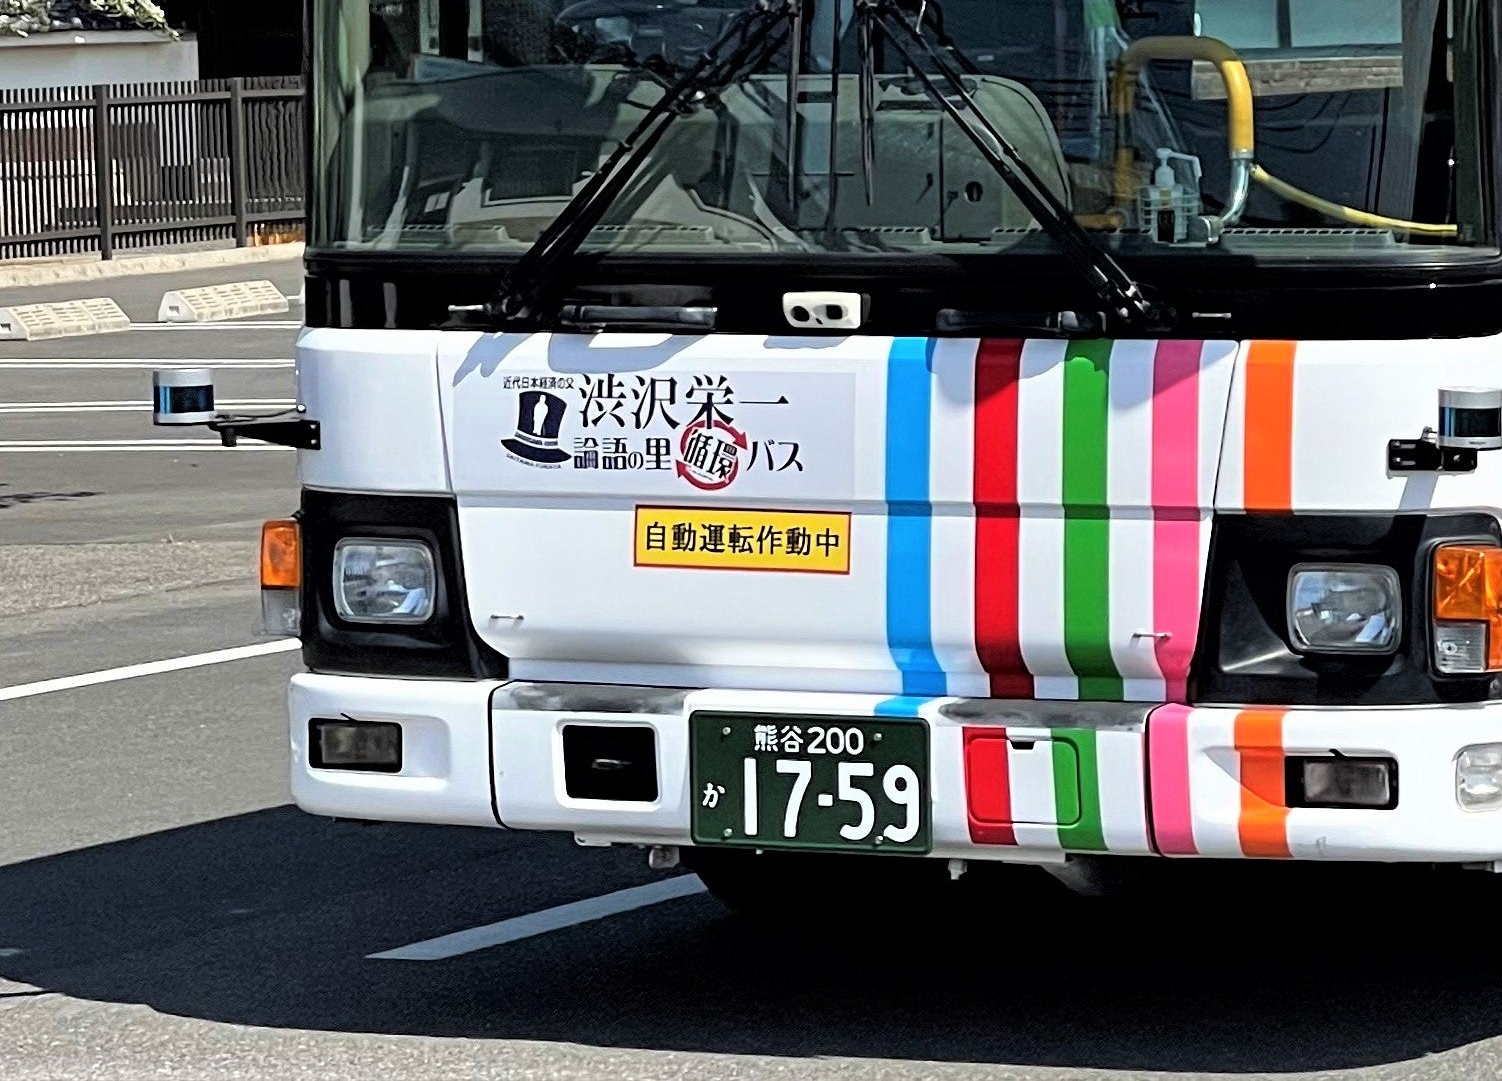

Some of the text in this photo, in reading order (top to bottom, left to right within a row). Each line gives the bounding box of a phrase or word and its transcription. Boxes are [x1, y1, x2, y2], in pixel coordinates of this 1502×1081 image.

[578, 373, 790, 430] 渋沢栄一
[645, 521, 841, 557] 自動運転作動中
[702, 757, 920, 843] か 17-59
